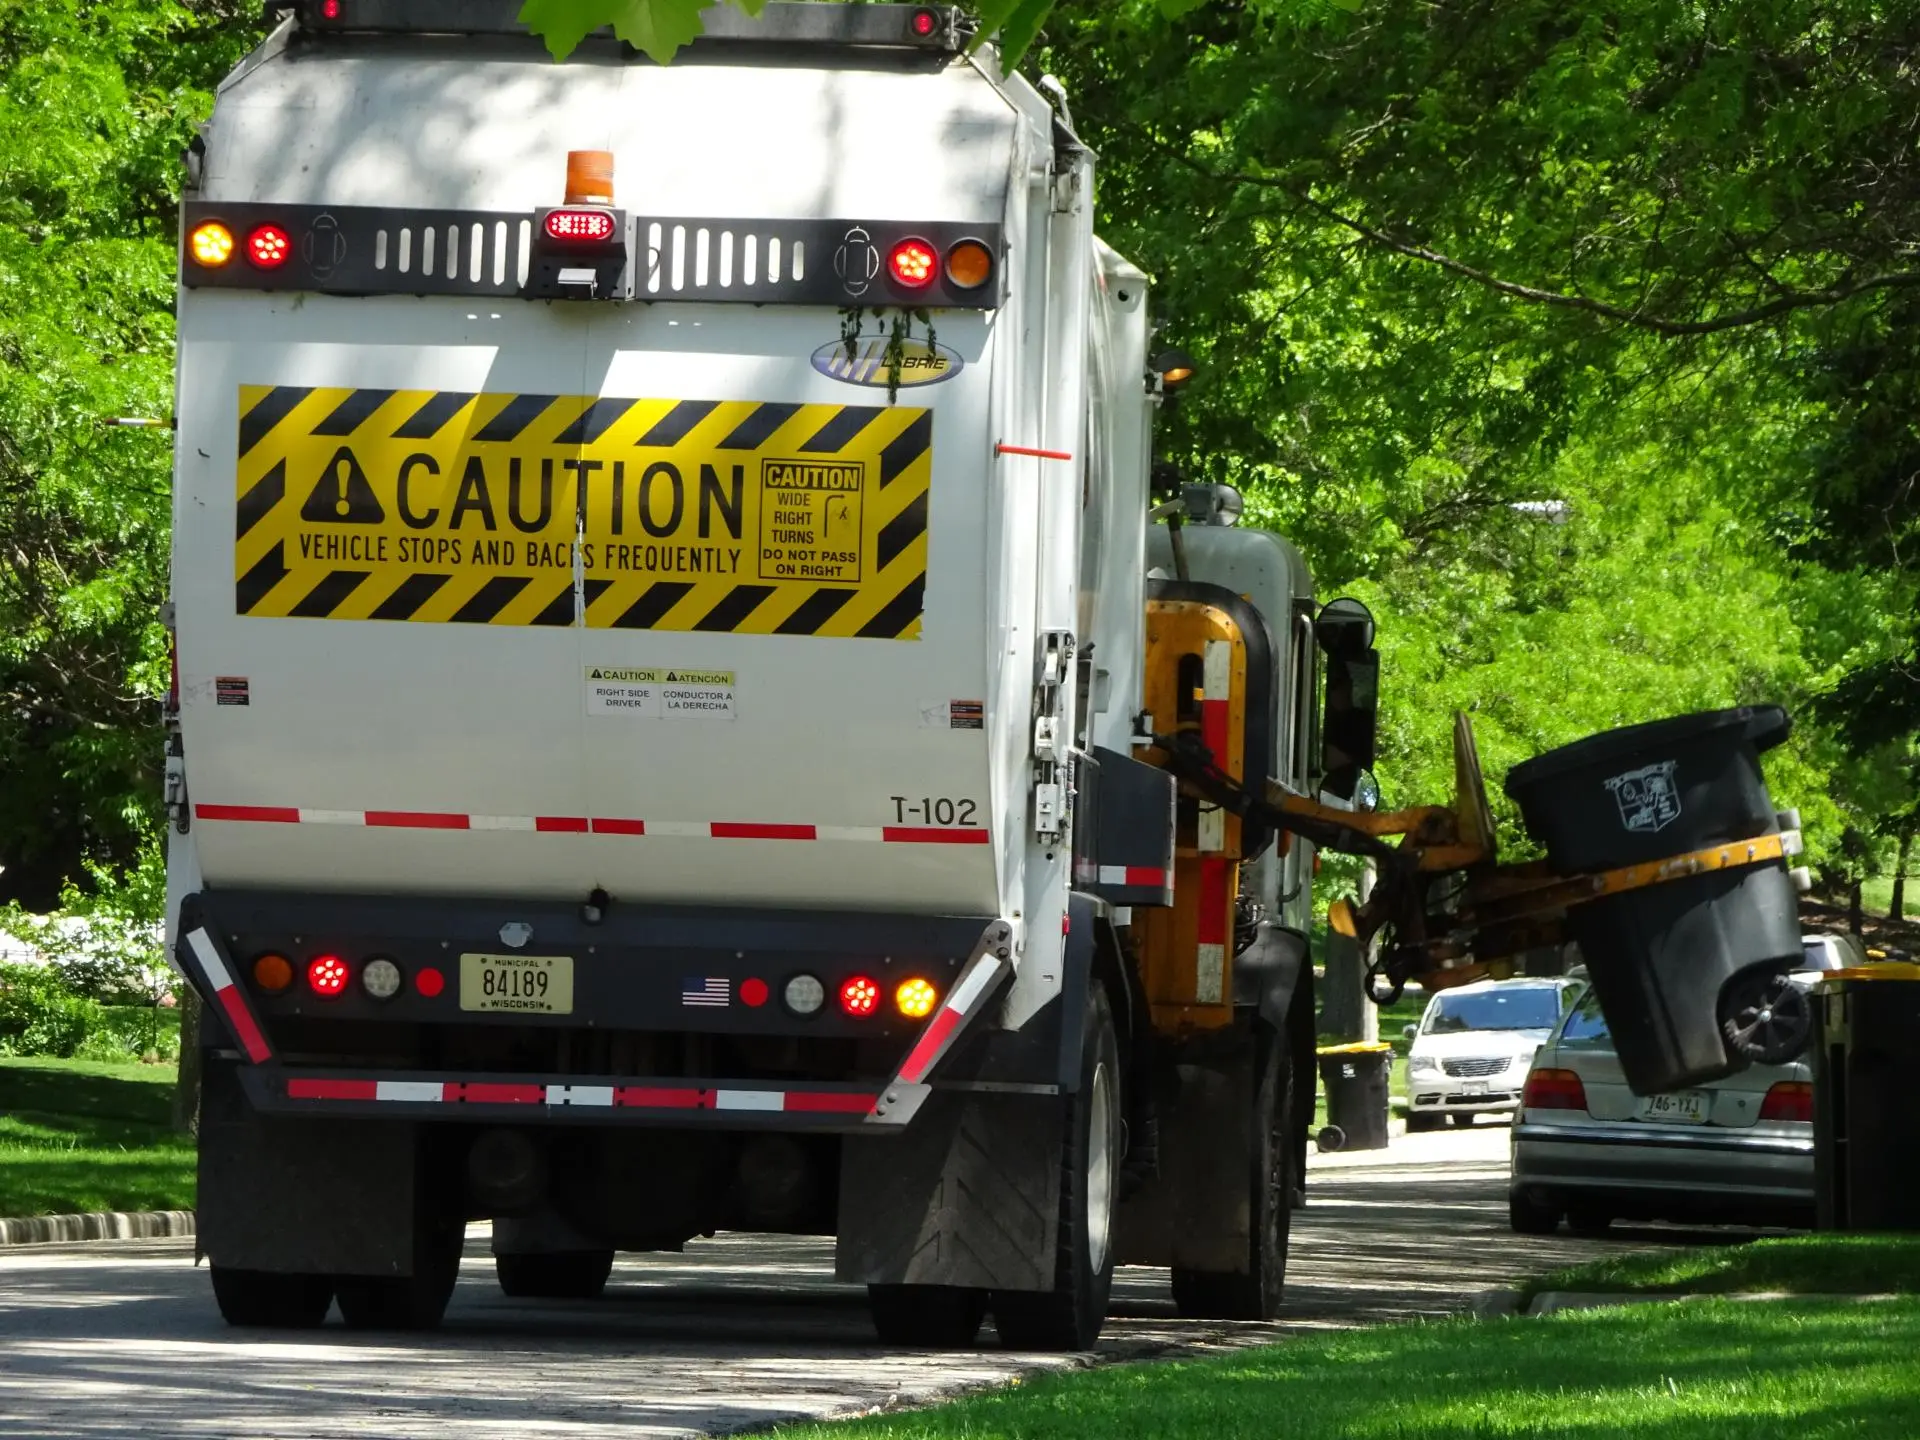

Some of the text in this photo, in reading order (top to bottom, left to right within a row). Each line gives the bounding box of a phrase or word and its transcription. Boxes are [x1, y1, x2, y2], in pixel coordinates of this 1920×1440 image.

[881, 357, 948, 369] LBRIE
[767, 465, 858, 489] CAUTION
[397, 453, 744, 539] CAUTION
[777, 492, 811, 506] WIDE
[774, 511, 813, 525] RIGHT
[772, 529, 814, 544] TURNS
[300, 533, 388, 562] VEHICLE
[398, 537, 462, 564] STOPS
[472, 540, 515, 566] AND
[605, 543, 742, 574] FREQUENTLY
[763, 549, 857, 563] DO NOT PASS
[776, 563, 843, 577] ON RIGHT
[603, 670, 655, 681] CAUTION
[596, 688, 650, 698] RIGHT SIDE
[663, 690, 723, 700] CONDUCTOR
[606, 700, 641, 708] DRIVER
[683, 702, 729, 710] DERECHA
[890, 796, 978, 826] T-102
[495, 959, 541, 968] MUNICIPAL
[483, 969, 548, 997] 84189
[491, 1000, 545, 1009] WISCONSIN
